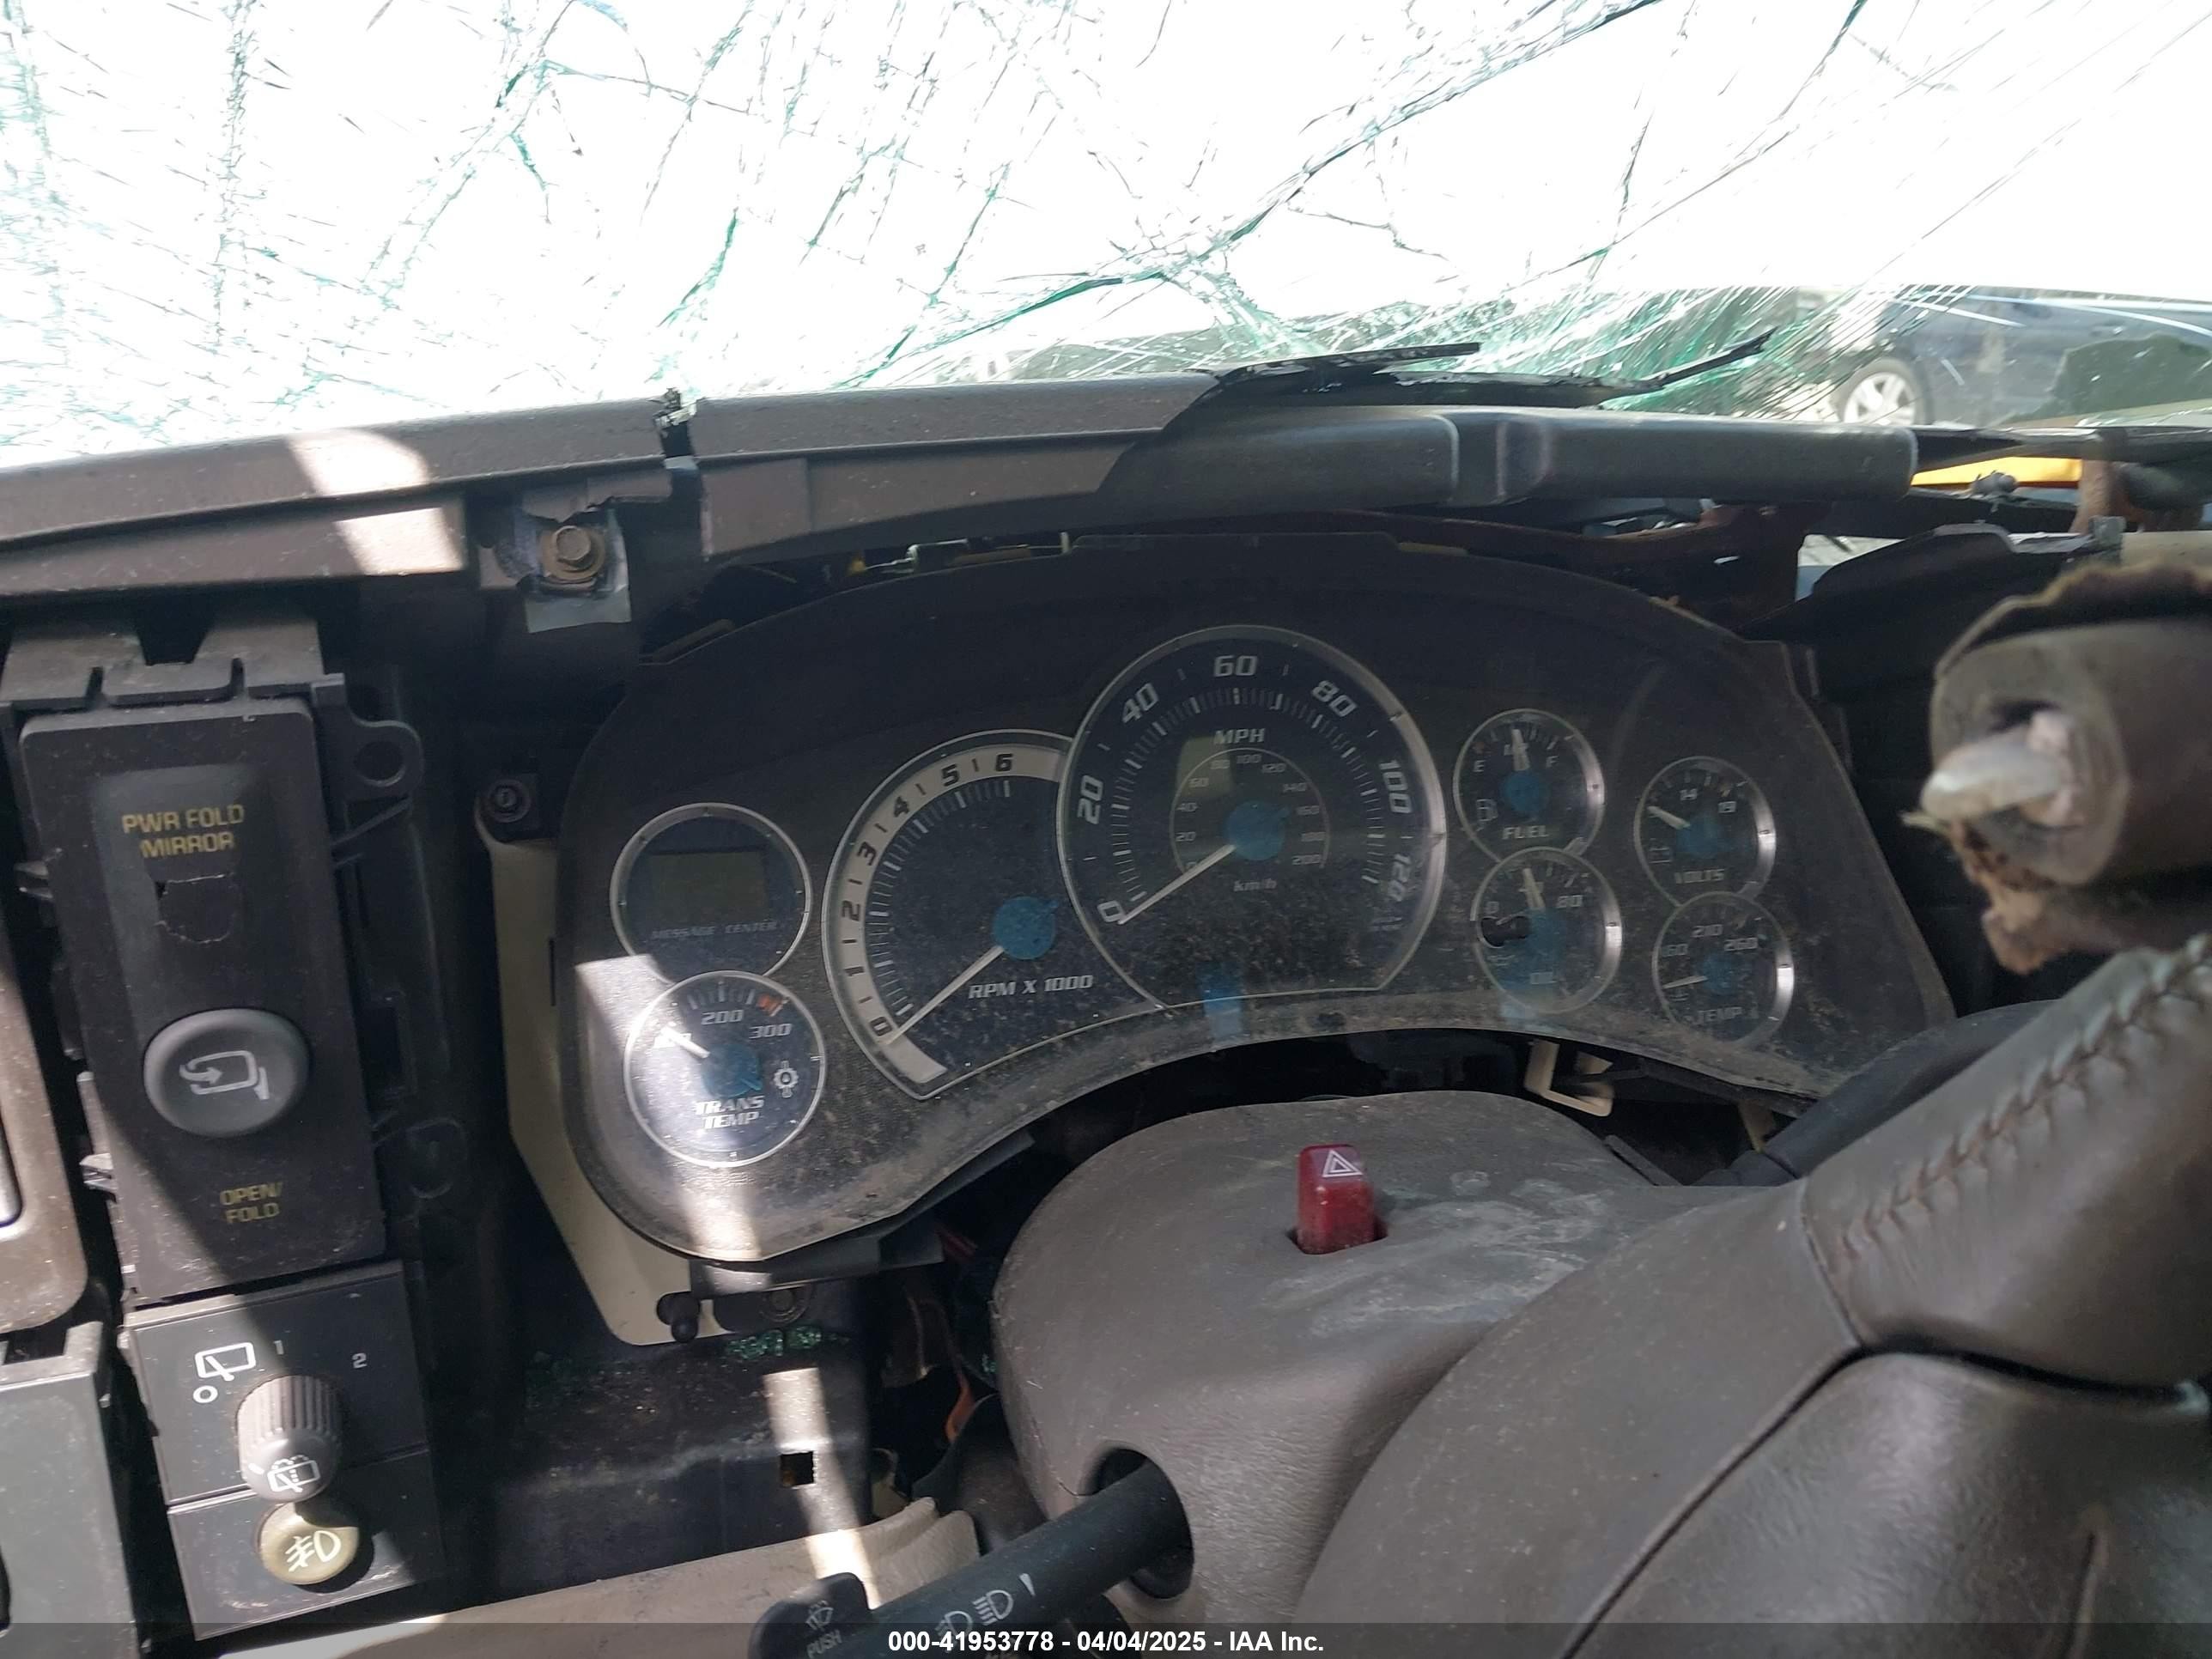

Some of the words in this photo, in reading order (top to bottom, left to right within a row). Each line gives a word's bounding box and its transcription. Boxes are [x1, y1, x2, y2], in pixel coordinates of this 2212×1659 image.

[1212, 654, 1258, 678] 60
[1120, 681, 1160, 725] 40
[1310, 679, 1358, 718] 80
[1212, 727, 1266, 745] MPH
[994, 753, 1014, 772] 6
[1472, 759, 1486, 773] E
[1546, 755, 1559, 769] F
[941, 764, 961, 787] 5
[1378, 757, 1413, 815] 100
[891, 795, 910, 819] 4
[1076, 775, 1104, 825] 20
[121, 811, 181, 834] PWR
[185, 804, 246, 827] FOLD
[1501, 824, 1550, 841] FUEL
[140, 831, 234, 859] MIRROR
[856, 842, 877, 866] 3
[841, 900, 862, 922] 2
[1097, 900, 1122, 922] 0
[847, 965, 866, 978] 1
[969, 981, 1017, 1000] RPM
[1022, 979, 1039, 994] X
[1044, 974, 1093, 993] 1000
[701, 1008, 744, 1025] 200
[869, 1015, 893, 1037] 0
[748, 1023, 793, 1040] 300
[696, 1095, 765, 1115] TRANS
[702, 1111, 761, 1130] TEMP
[220, 1182, 283, 1206] OPEN/
[226, 1203, 280, 1224] FOLD
[274, 1340, 285, 1356] 1
[352, 1352, 368, 1370] 2
